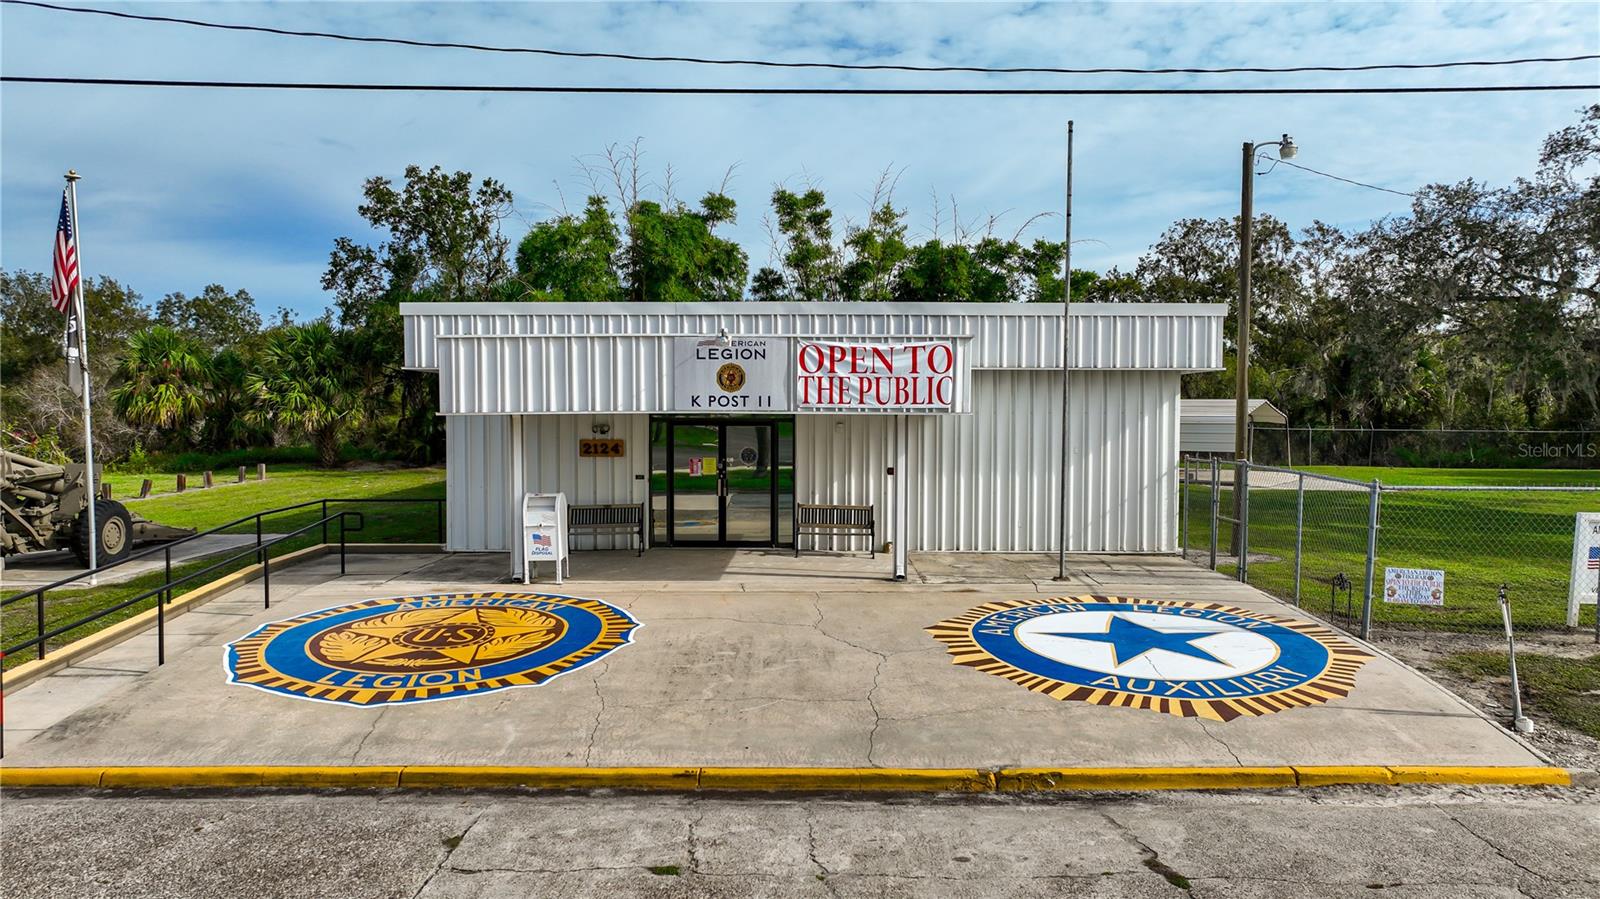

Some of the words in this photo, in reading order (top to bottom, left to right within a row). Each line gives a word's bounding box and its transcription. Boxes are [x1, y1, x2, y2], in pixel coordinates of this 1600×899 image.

[696, 348, 766, 360] LEGION
[799, 344, 894, 374] OPEN
[904, 345, 953, 374] TO
[798, 375, 851, 405] THE
[858, 375, 953, 405] PUBLIC
[691, 395, 701, 407] K
[708, 395, 749, 407] POST
[583, 442, 621, 454] 2124
[396, 598, 567, 611] AMERICAN
[978, 604, 1086, 636] AMERICAN
[1133, 605, 1273, 629] LEGION
[316, 668, 481, 688] LEGION
[1089, 665, 1308, 697] AUXILIARY
